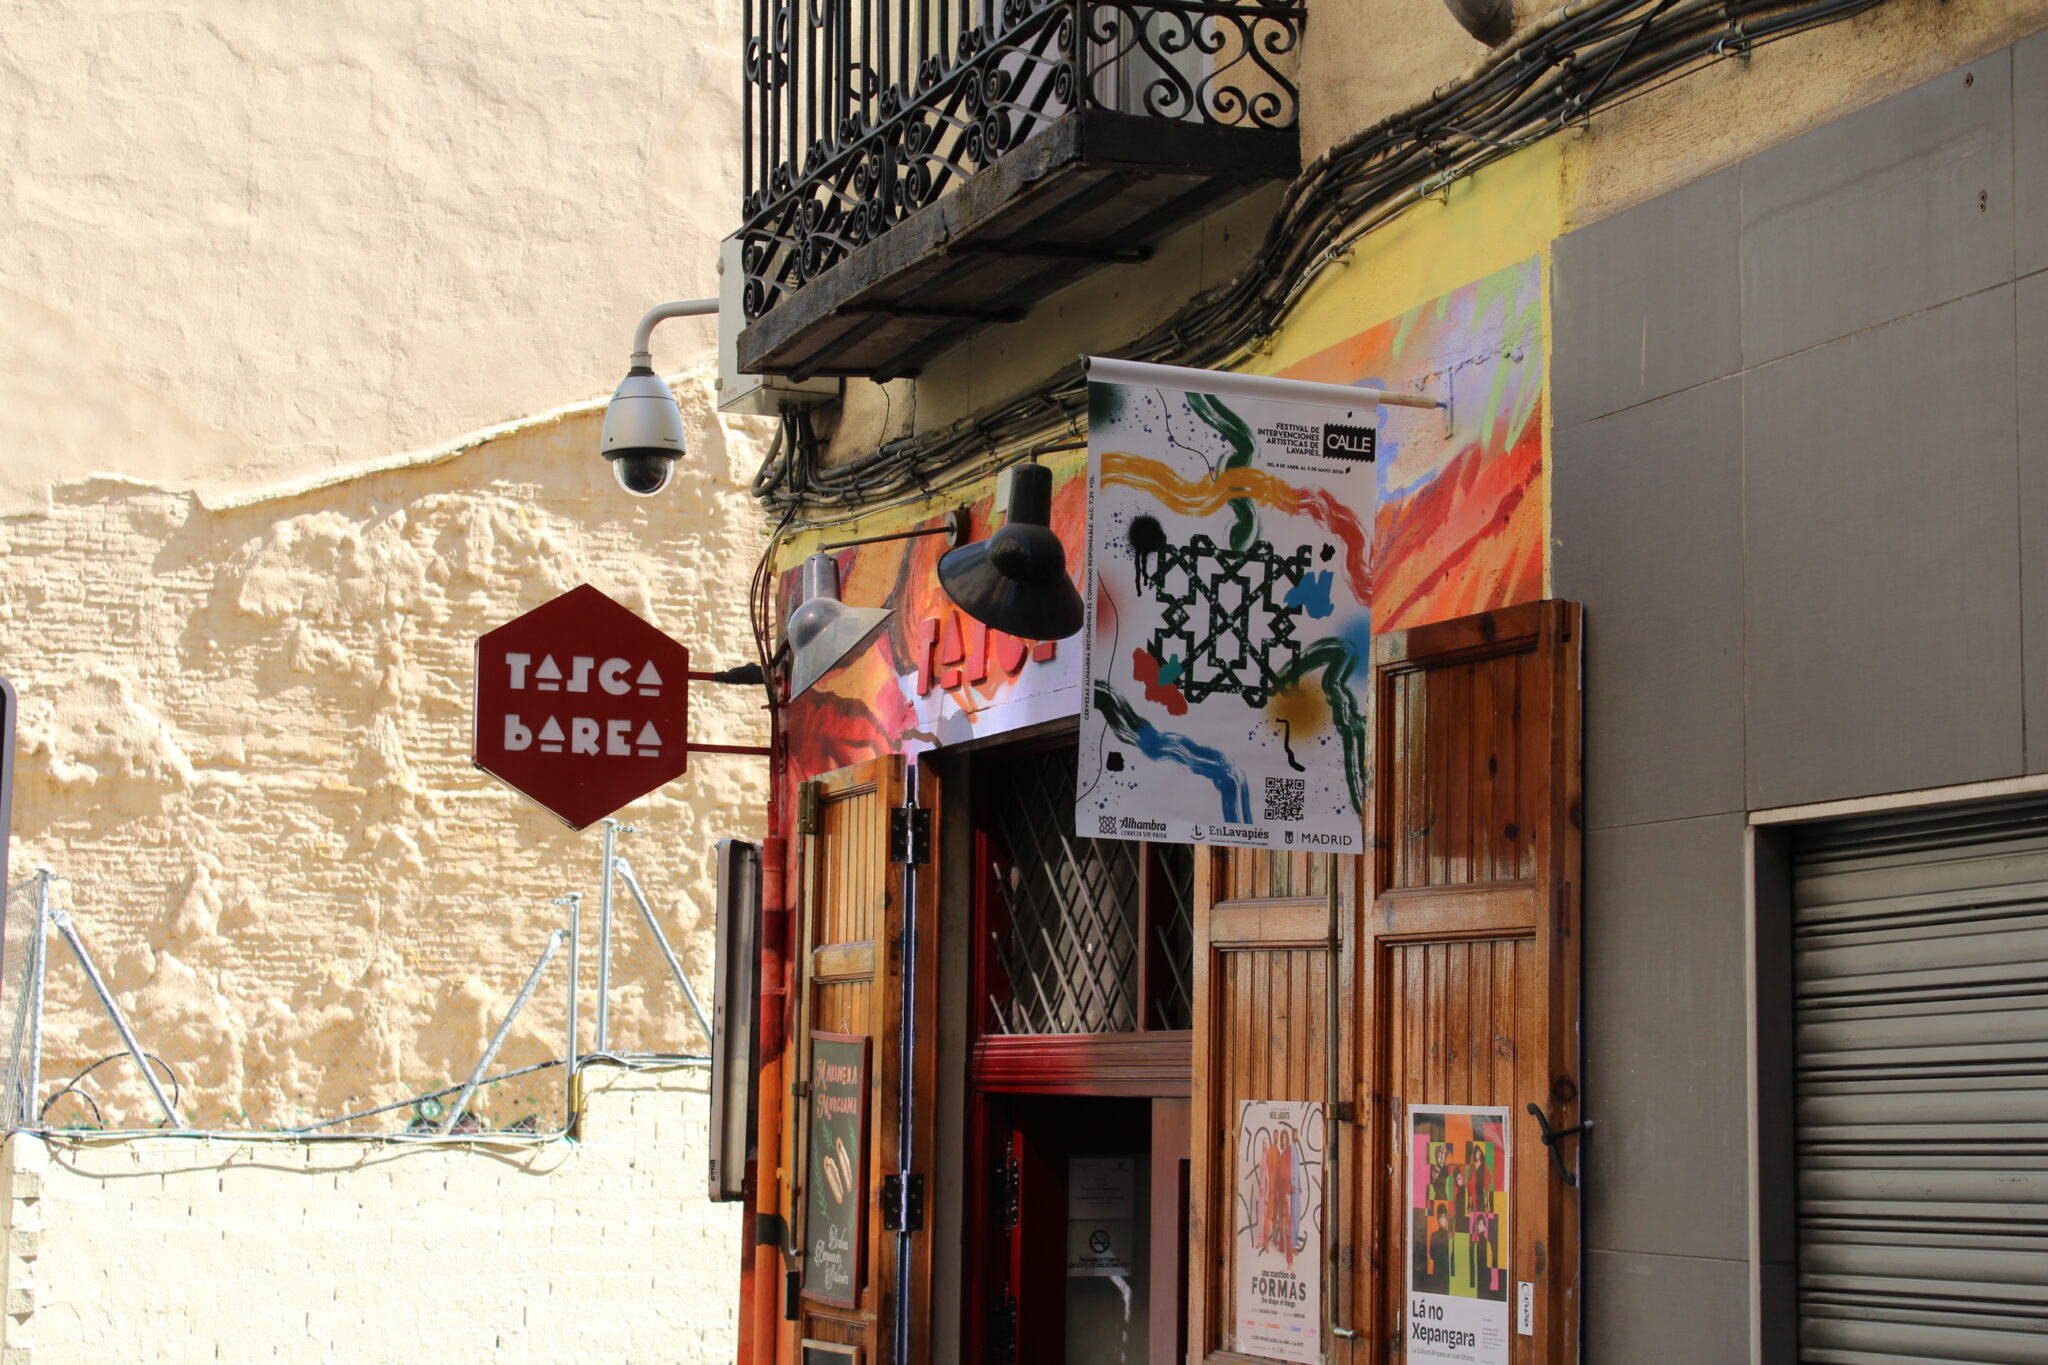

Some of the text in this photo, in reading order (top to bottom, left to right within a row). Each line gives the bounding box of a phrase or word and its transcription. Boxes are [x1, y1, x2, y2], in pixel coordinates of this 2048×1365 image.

[1257, 428, 1320, 441] INTERVENCIONES
[1276, 422, 1320, 434] FESTIVAL DE
[1327, 434, 1371, 452] CALLE
[1086, 602, 1092, 610] EL
[505, 652, 663, 696] TASCA
[1119, 816, 1167, 832] Alhambra
[1208, 825, 1270, 840] EnLavapiés
[1301, 833, 1352, 846] MADRID
[1290, 1270, 1296, 1280] de
[1251, 1276, 1307, 1302] FORMAS
[1412, 1299, 1443, 1321] Lá no
[1412, 1322, 1476, 1350] Xepangara
